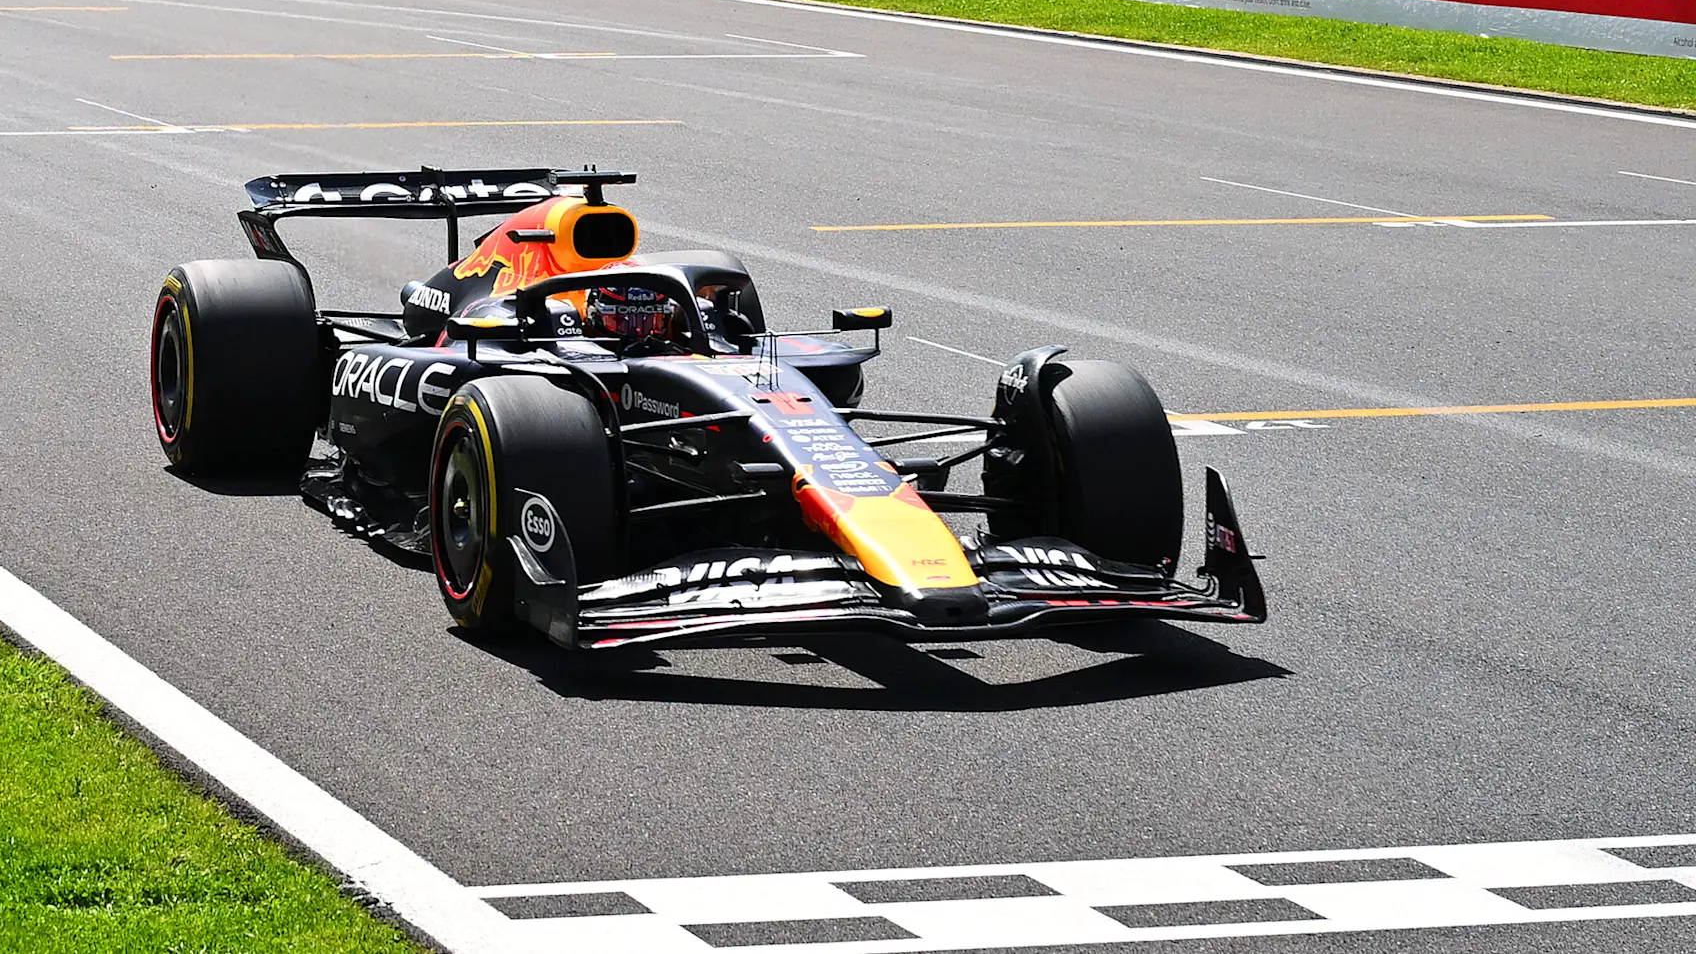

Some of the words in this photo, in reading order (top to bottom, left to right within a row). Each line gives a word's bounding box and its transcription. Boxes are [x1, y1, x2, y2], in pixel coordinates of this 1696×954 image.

[408, 285, 451, 316] ONDA
[557, 326, 583, 336] Gate
[332, 351, 457, 416] ORACLE
[634, 391, 680, 419] 1Password
[526, 509, 551, 537] Esso
[912, 558, 947, 566] HRC
